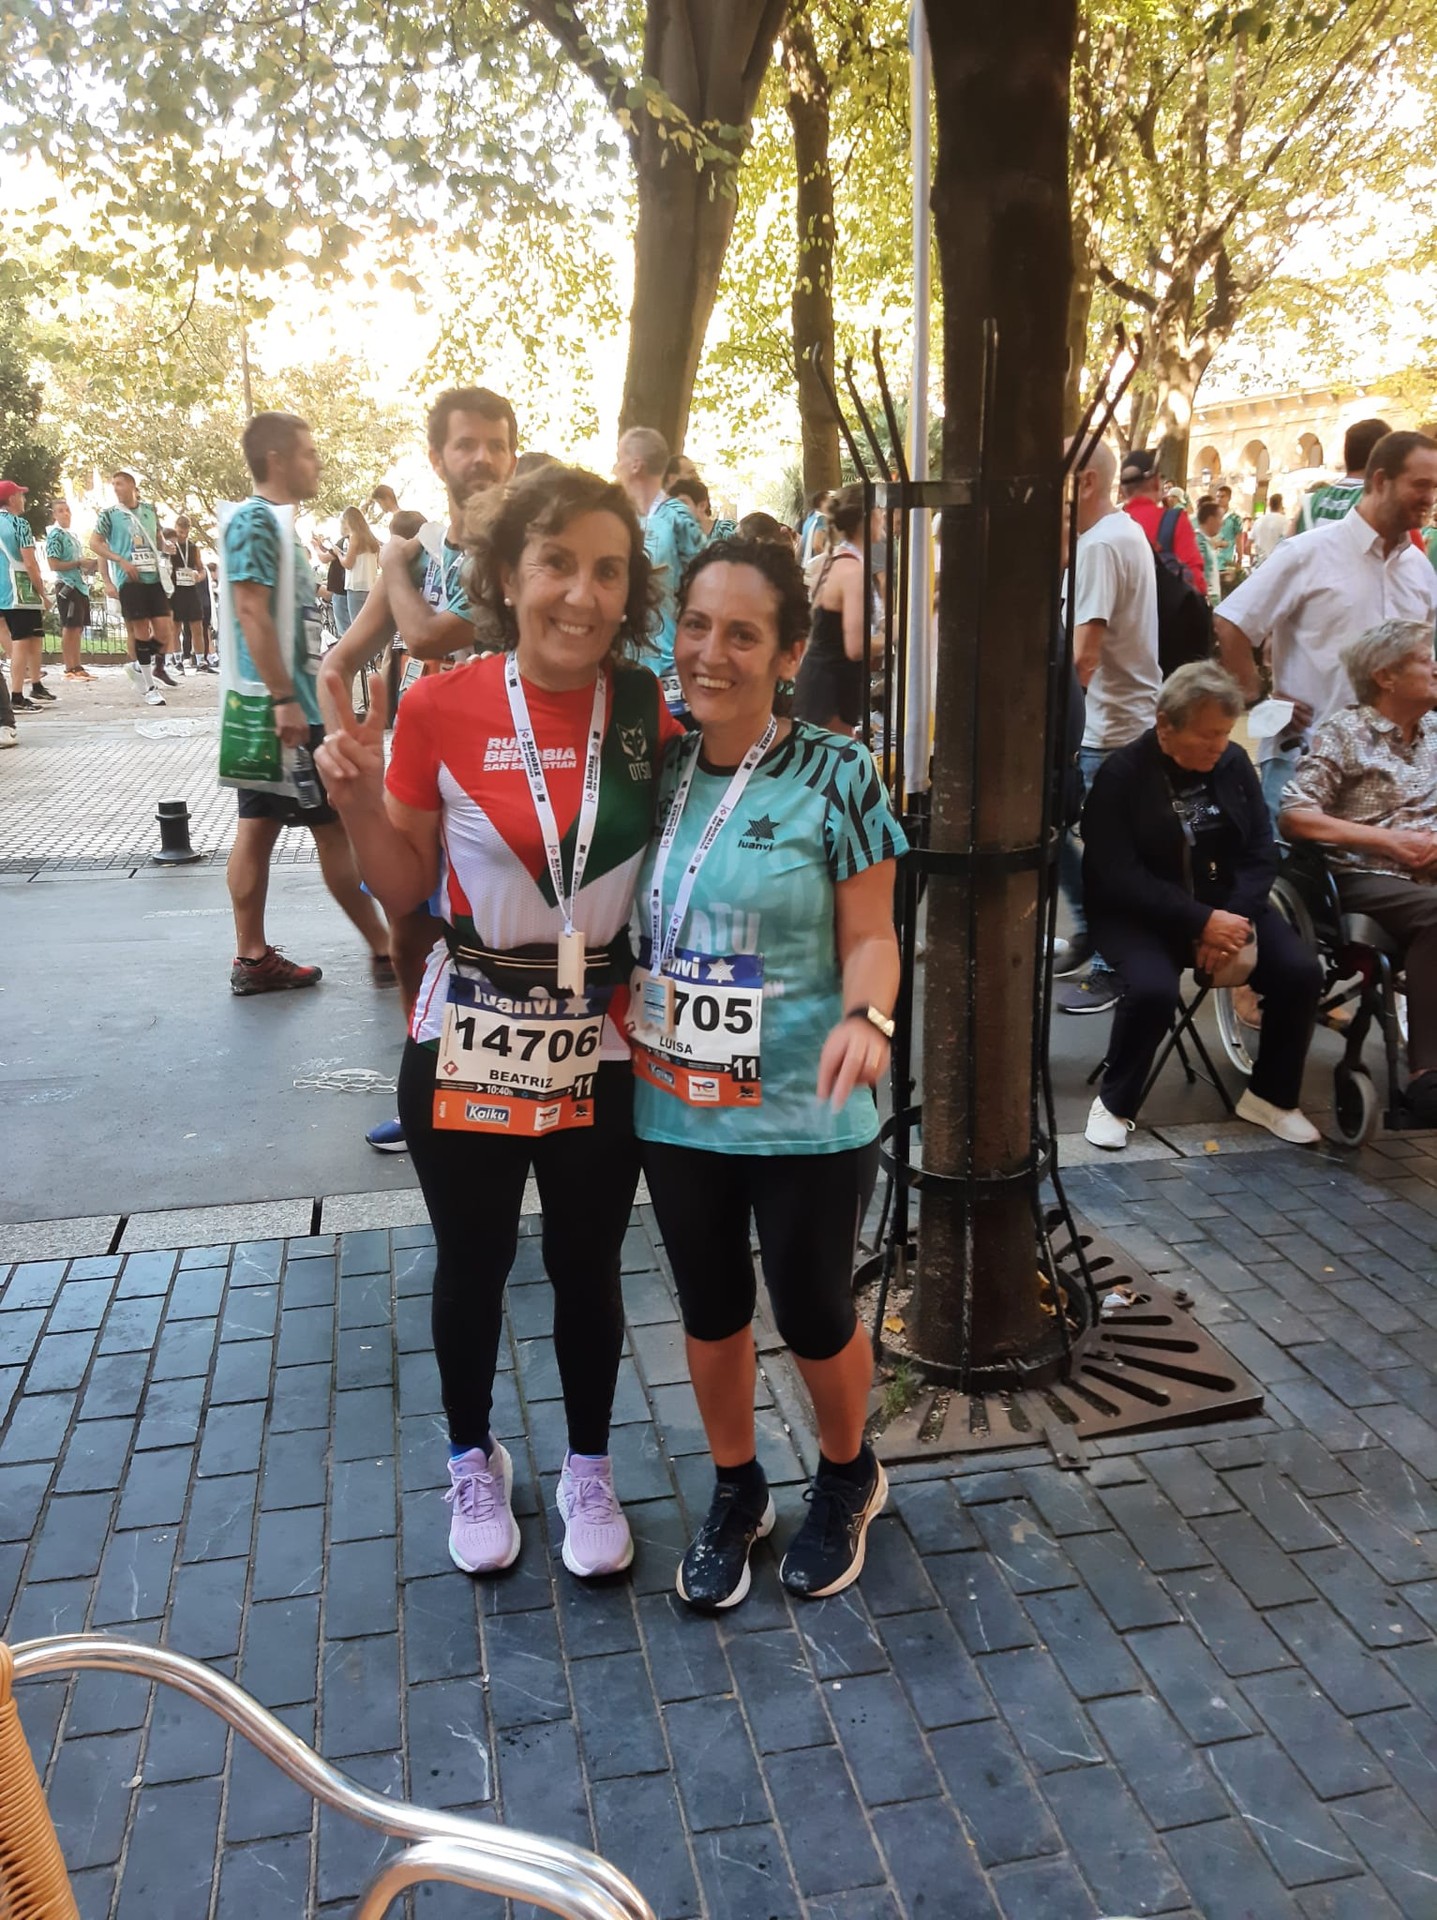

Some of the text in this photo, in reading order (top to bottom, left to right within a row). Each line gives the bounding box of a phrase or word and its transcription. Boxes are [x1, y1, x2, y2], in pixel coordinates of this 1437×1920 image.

[484, 747, 576, 762] BEHBIA
[483, 761, 576, 771] SAN SESTIAN
[738, 839, 774, 851] luanvi
[667, 902, 760, 955] ATU
[455, 1016, 599, 1063] 14706
[659, 1036, 693, 1055] LUISA
[733, 1058, 757, 1079] 11
[489, 1069, 553, 1088] BEATRIZ
[574, 1075, 593, 1098] 11
[468, 1105, 507, 1121] Kaiku
